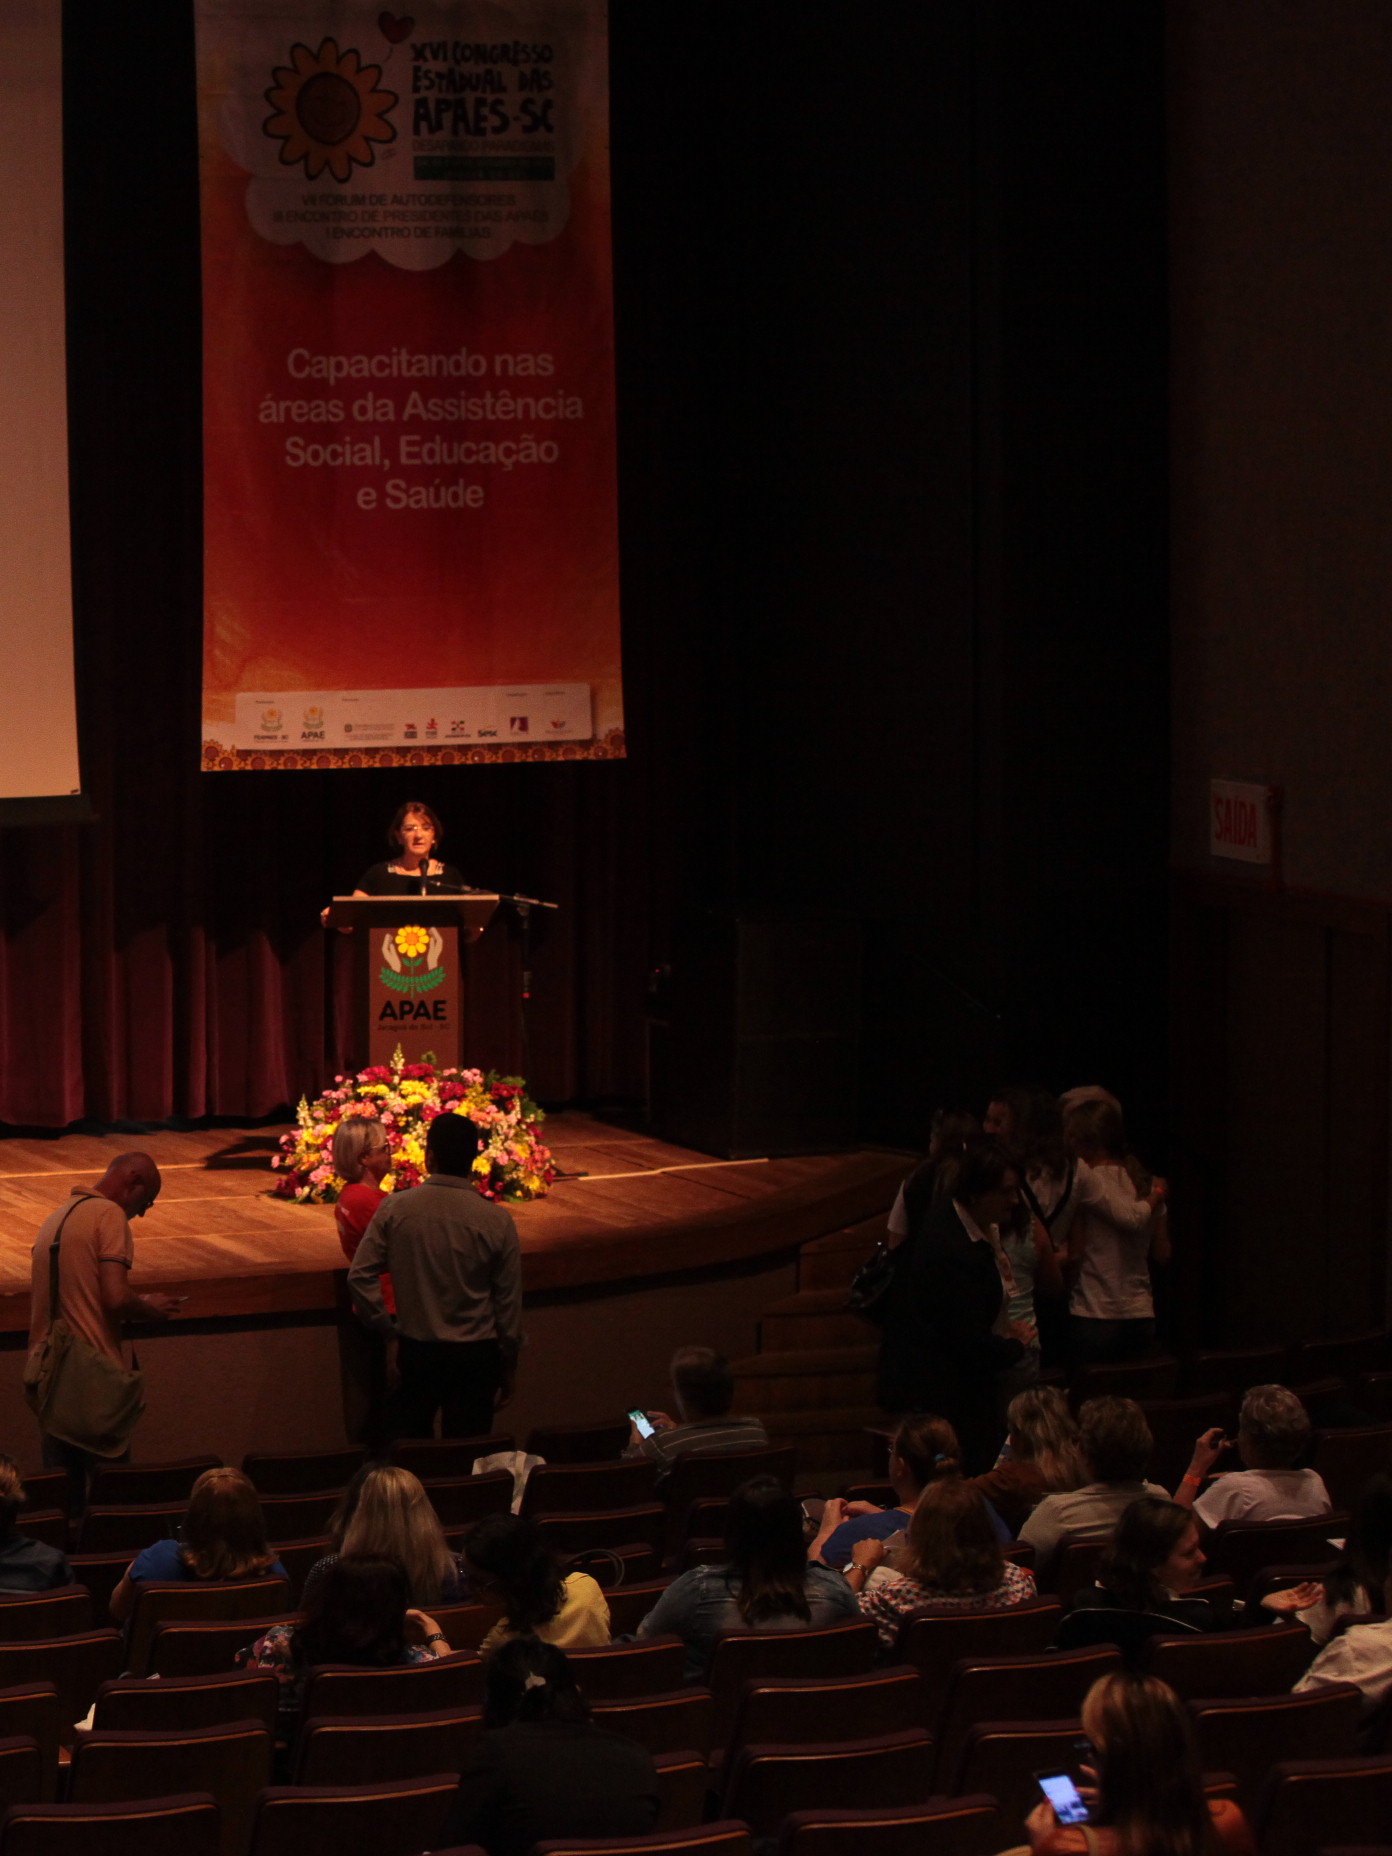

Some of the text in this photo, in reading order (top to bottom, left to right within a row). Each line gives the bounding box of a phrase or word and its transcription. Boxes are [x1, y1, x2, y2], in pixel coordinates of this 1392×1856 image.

[410, 40, 554, 66] XVI CONGRESSO
[412, 65, 554, 94] ESTADUAL DAS
[412, 96, 555, 137] APAES-SC
[369, 193, 388, 206] DE
[286, 210, 358, 223] ENCONTRO
[361, 209, 381, 223] DE
[383, 209, 472, 223] PRESIDENTES
[474, 209, 503, 222] DAS
[332, 227, 412, 239] ENCONTRO
[414, 226, 432, 239] DE
[287, 348, 555, 385] Capacitando nas
[259, 390, 584, 423] áreas da Assistência
[284, 434, 559, 472] Social, Educação
[356, 478, 485, 510] e Saúde
[301, 731, 326, 740] APAE
[1215, 796, 1257, 848] SAÍDA
[379, 1000, 447, 1020] APAE
